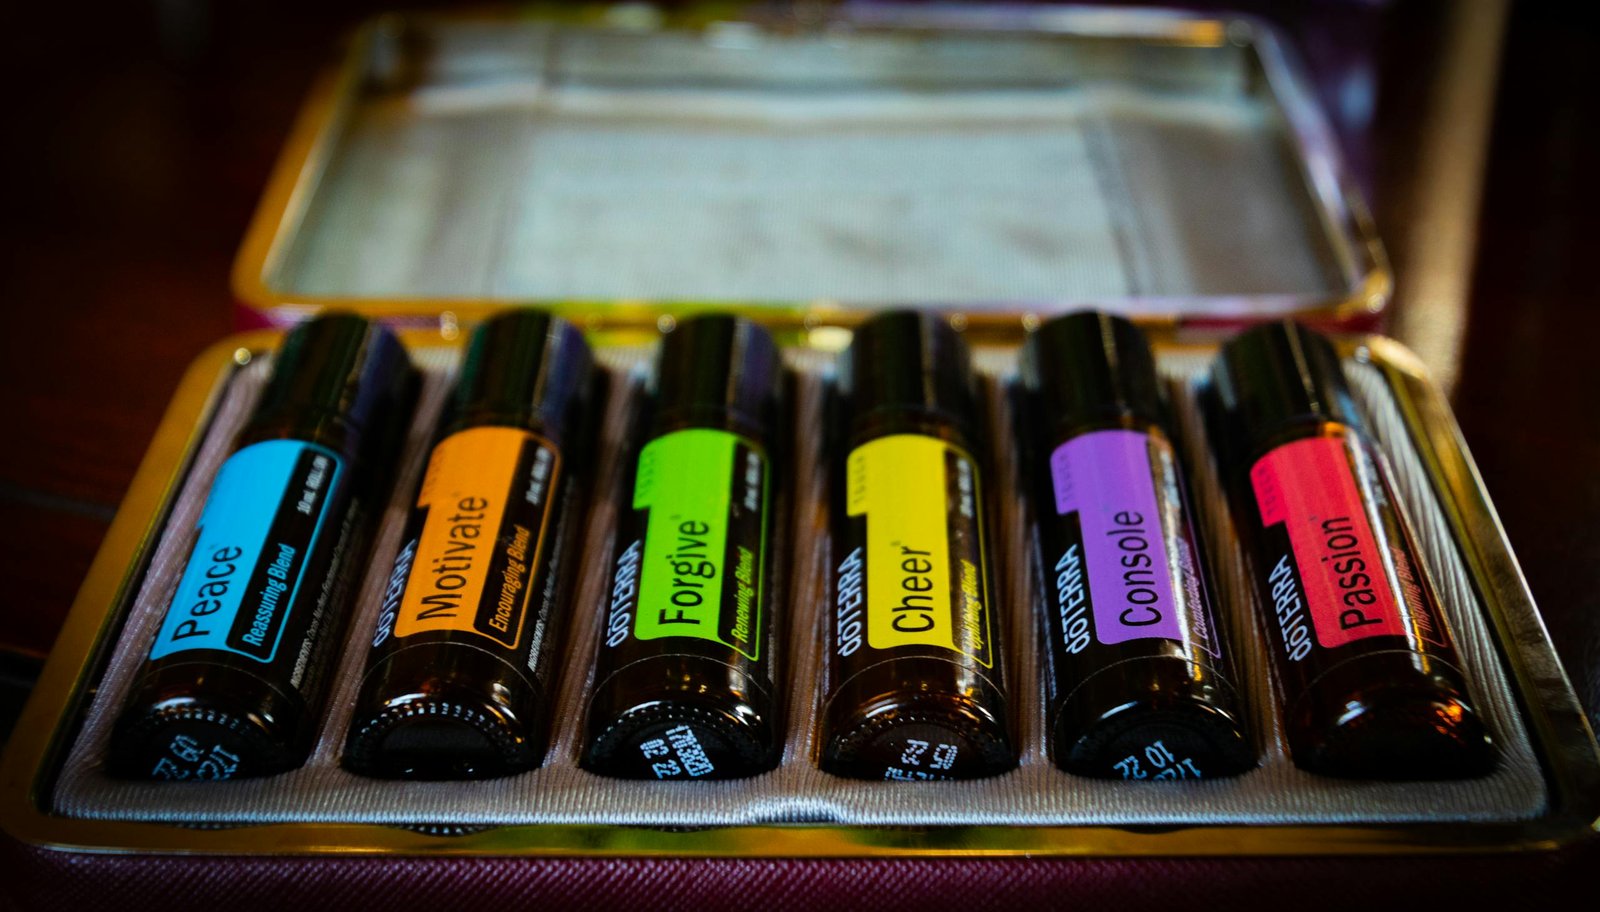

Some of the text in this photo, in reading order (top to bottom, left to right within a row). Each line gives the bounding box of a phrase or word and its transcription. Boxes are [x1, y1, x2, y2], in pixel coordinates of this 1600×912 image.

[172, 545, 242, 641] Peace
[242, 543, 296, 648] Reassuring Blend
[416, 496, 488, 621] Motivate
[489, 524, 531, 634] Encouraging Blend
[658, 520, 717, 626] Forgive
[731, 546, 755, 644] Renewing Blend
[892, 547, 934, 633] Cheer
[961, 560, 984, 649] Uplifting Blend
[1107, 510, 1162, 626] Console
[1322, 516, 1382, 630] Passion
[1403, 580, 1433, 633] Inspiring
[1144, 741, 1176, 769] 10
